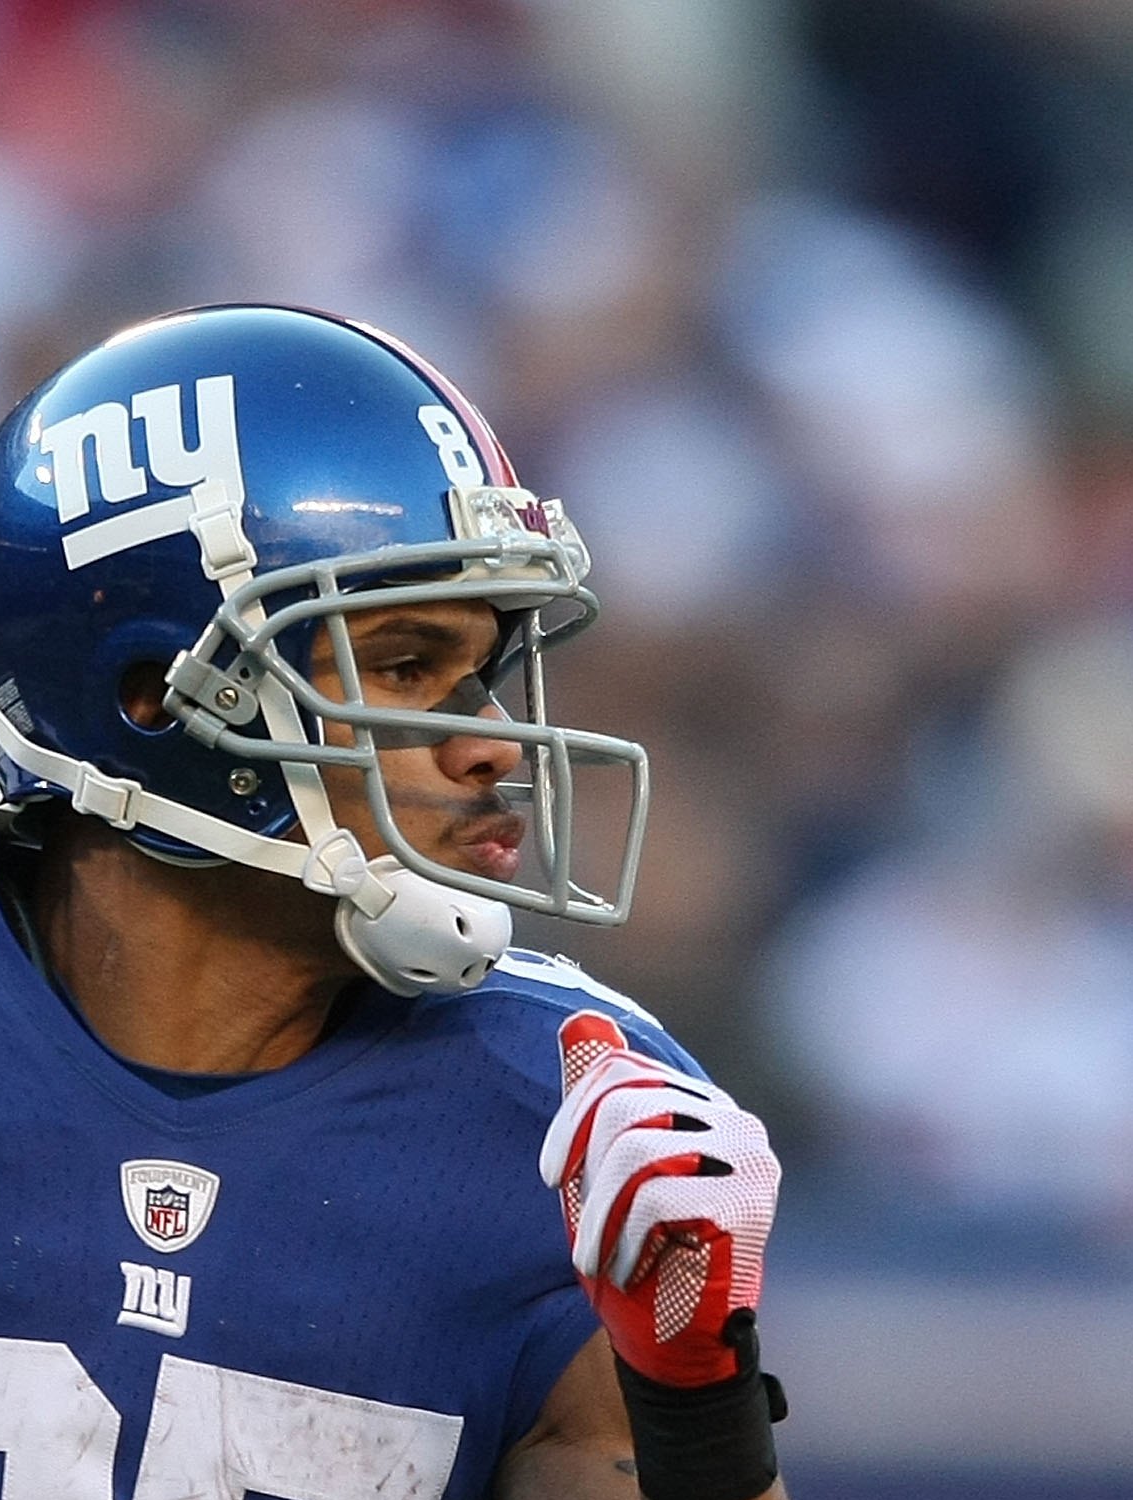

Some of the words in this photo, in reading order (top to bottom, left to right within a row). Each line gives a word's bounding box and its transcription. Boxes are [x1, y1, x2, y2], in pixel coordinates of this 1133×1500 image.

[417, 405, 484, 488] 8
[129, 1169, 210, 1195] EQUIPMENT
[148, 1207, 184, 1235] NFL
